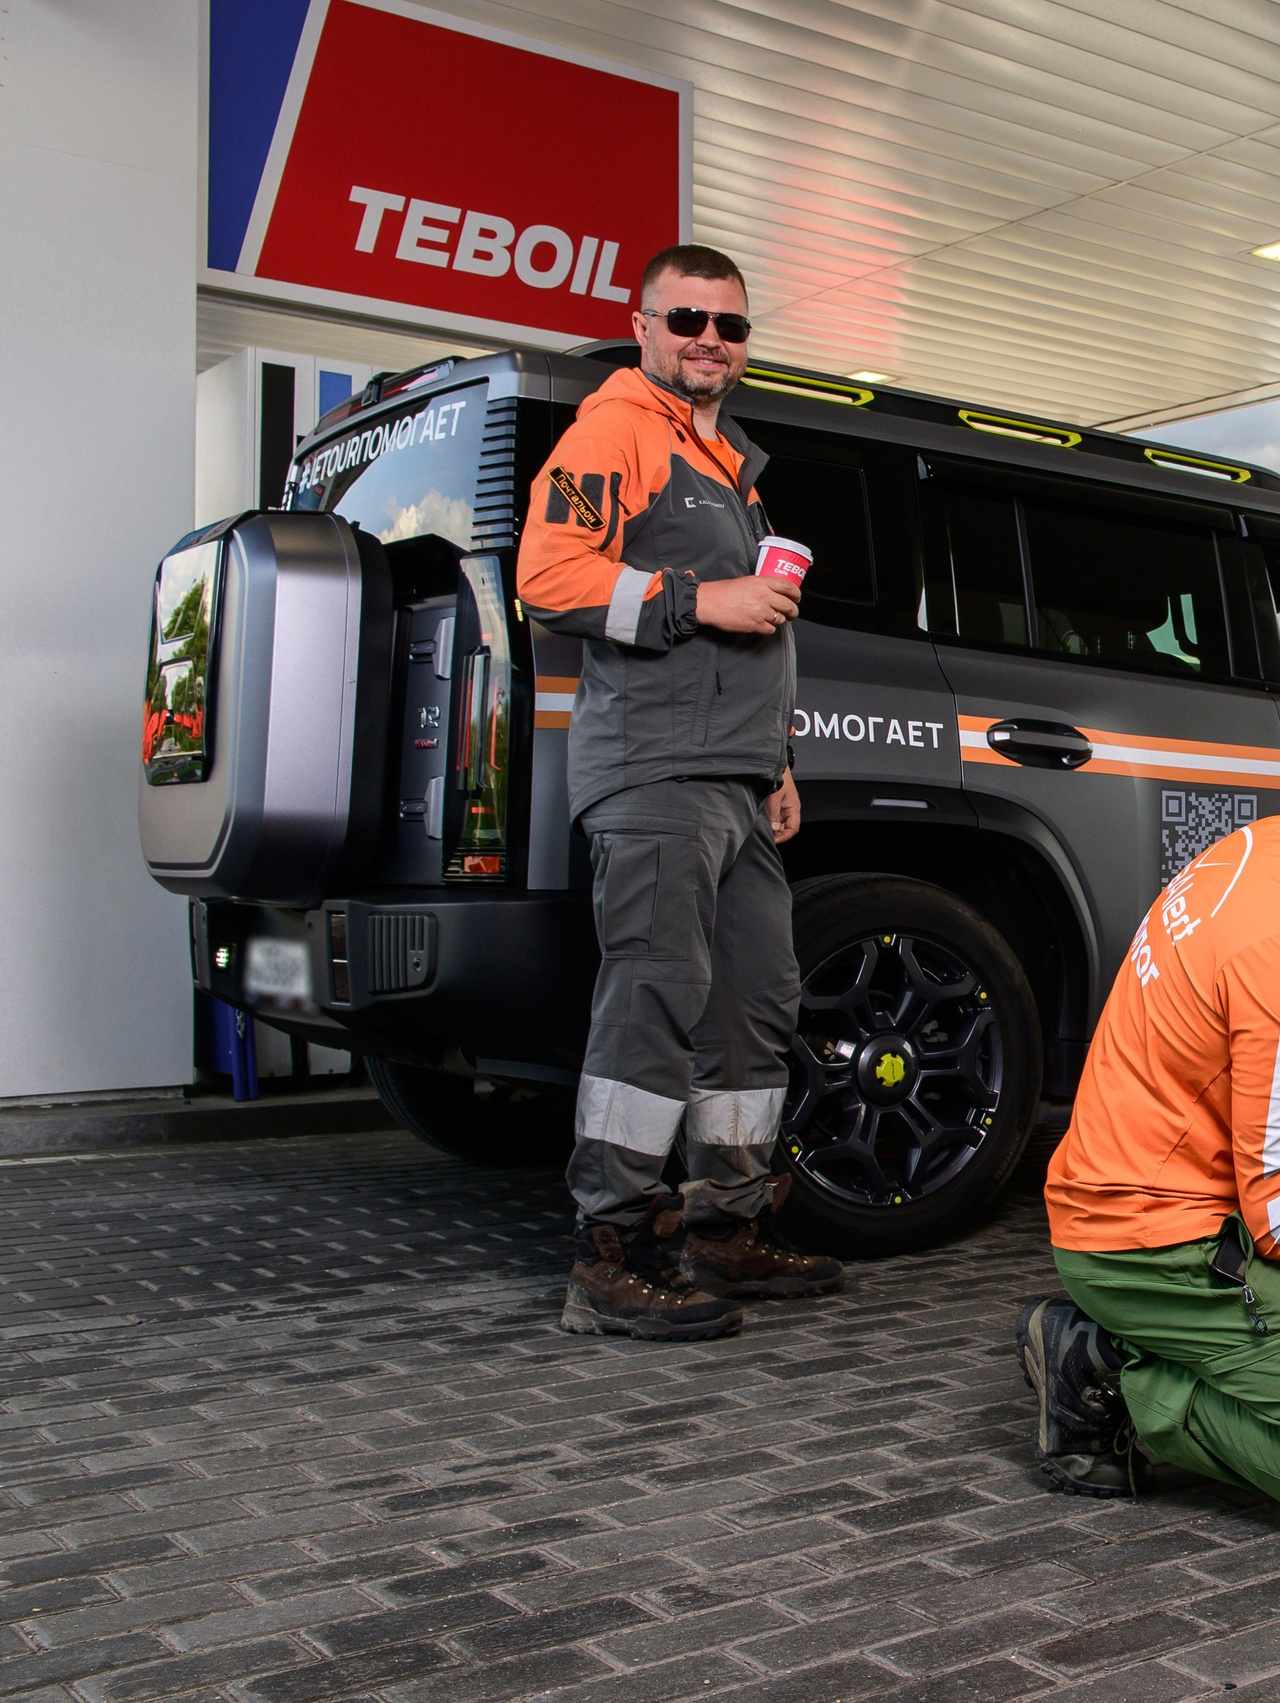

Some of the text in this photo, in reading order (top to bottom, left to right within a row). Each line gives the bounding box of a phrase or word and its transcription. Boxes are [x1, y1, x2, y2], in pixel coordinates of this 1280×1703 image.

[348, 185, 632, 304] TEBOIL
[555, 473, 597, 524] Почтальон
[793, 708, 944, 749] ОМОГАЕТ
